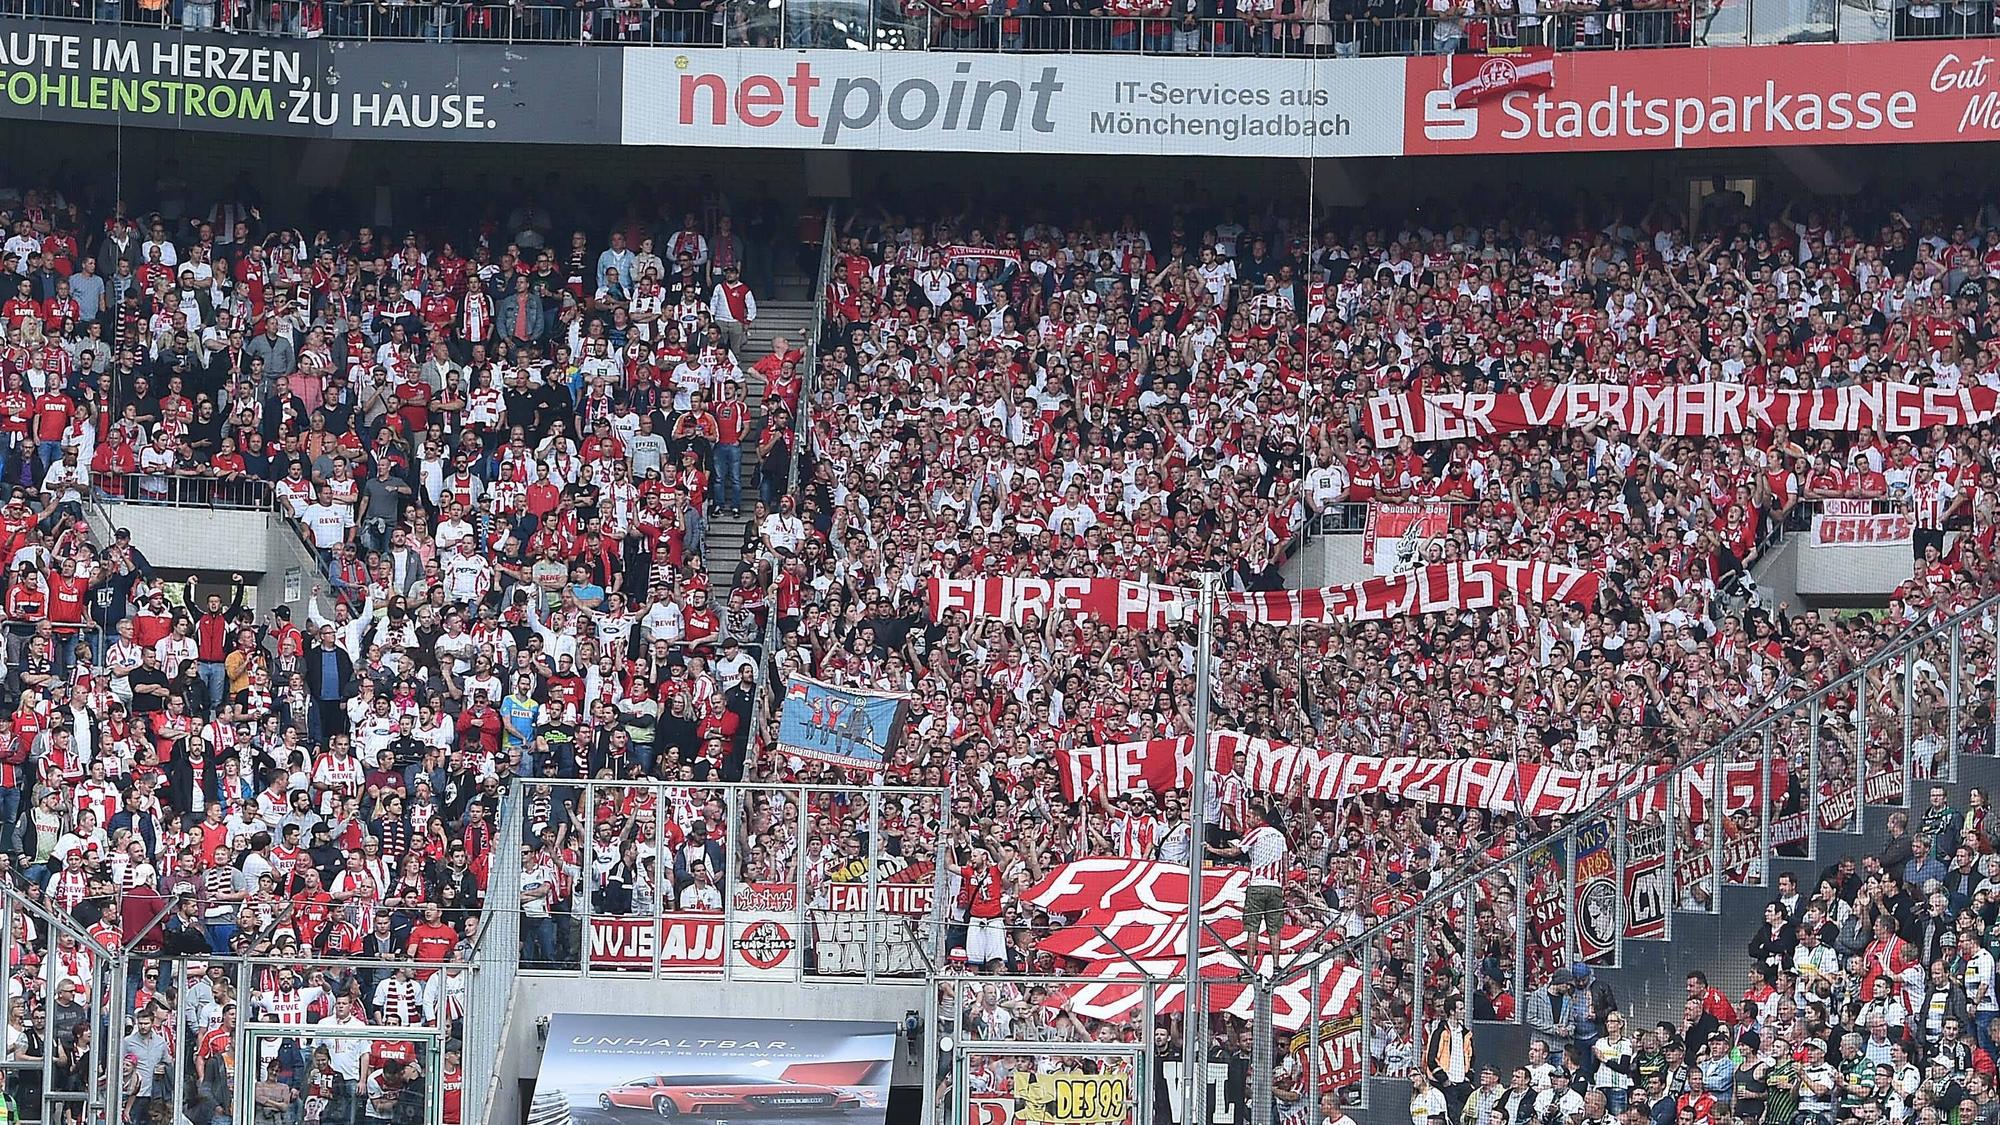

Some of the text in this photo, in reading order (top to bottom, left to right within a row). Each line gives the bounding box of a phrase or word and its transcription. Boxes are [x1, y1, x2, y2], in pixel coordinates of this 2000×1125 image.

[92, 38, 140, 73] IM
[152, 42, 311, 91] HERZEN,
[1930, 53, 1994, 93] Gut
[679, 61, 1063, 144] netpoint
[1115, 82, 1329, 106] IT-Services aus
[288, 90, 339, 126] ZU
[352, 94, 496, 129] HAUSE.
[1500, 80, 1917, 148] Stadtsparkasse
[1090, 111, 1350, 141] Mönchengladbach
[1369, 391, 1497, 449] EUER
[455, 567, 478, 575] PEPSI
[936, 577, 1092, 625] EURE
[655, 620, 676, 628] REWE
[512, 710, 531, 718] REWE
[1069, 740, 1149, 801] DIE
[36, 824, 58, 833] REWE
[275, 1004, 300, 1012] REWE
[380, 1051, 405, 1059] REWE
[572, 1036, 796, 1050] UNHALTBAR.
